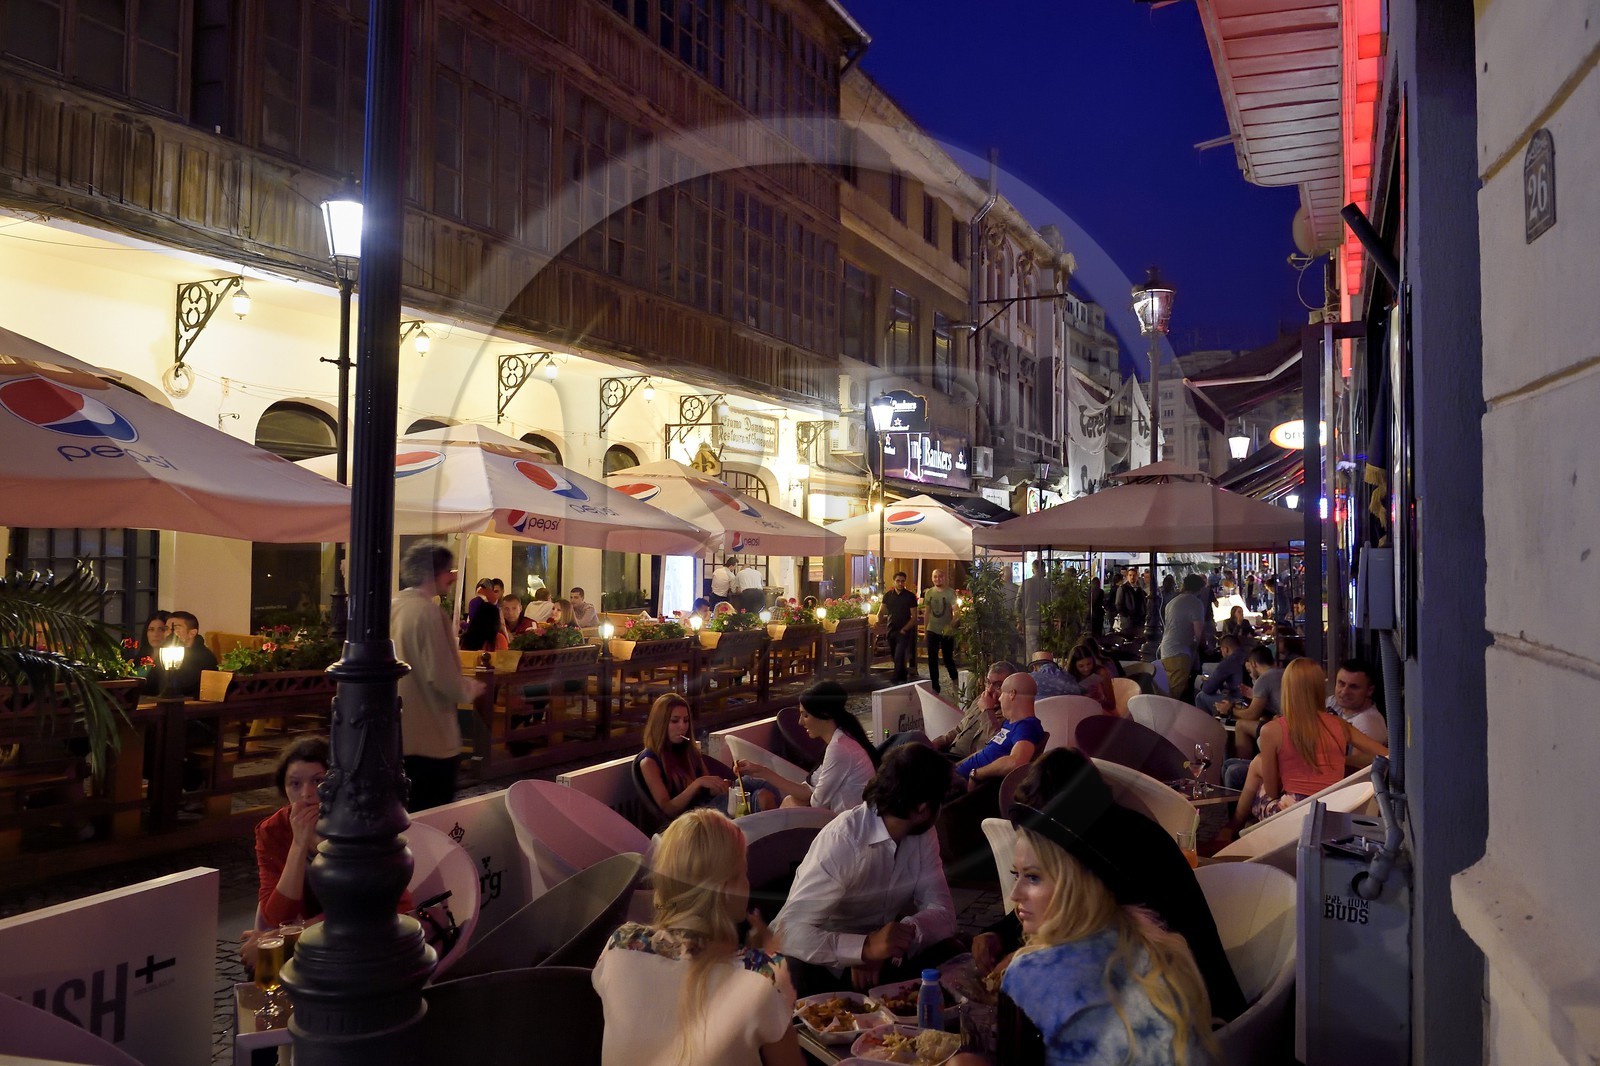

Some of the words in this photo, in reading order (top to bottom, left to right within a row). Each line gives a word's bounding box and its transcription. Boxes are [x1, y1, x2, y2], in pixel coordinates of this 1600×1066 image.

[1528, 164, 1548, 221] 26
[57, 444, 178, 471] pepsi
[922, 437, 952, 471] Bankers
[569, 504, 623, 518] pepsi
[528, 517, 561, 532] pepsi
[1324, 894, 1369, 909] PREIUM
[1323, 903, 1369, 924] BUDS
